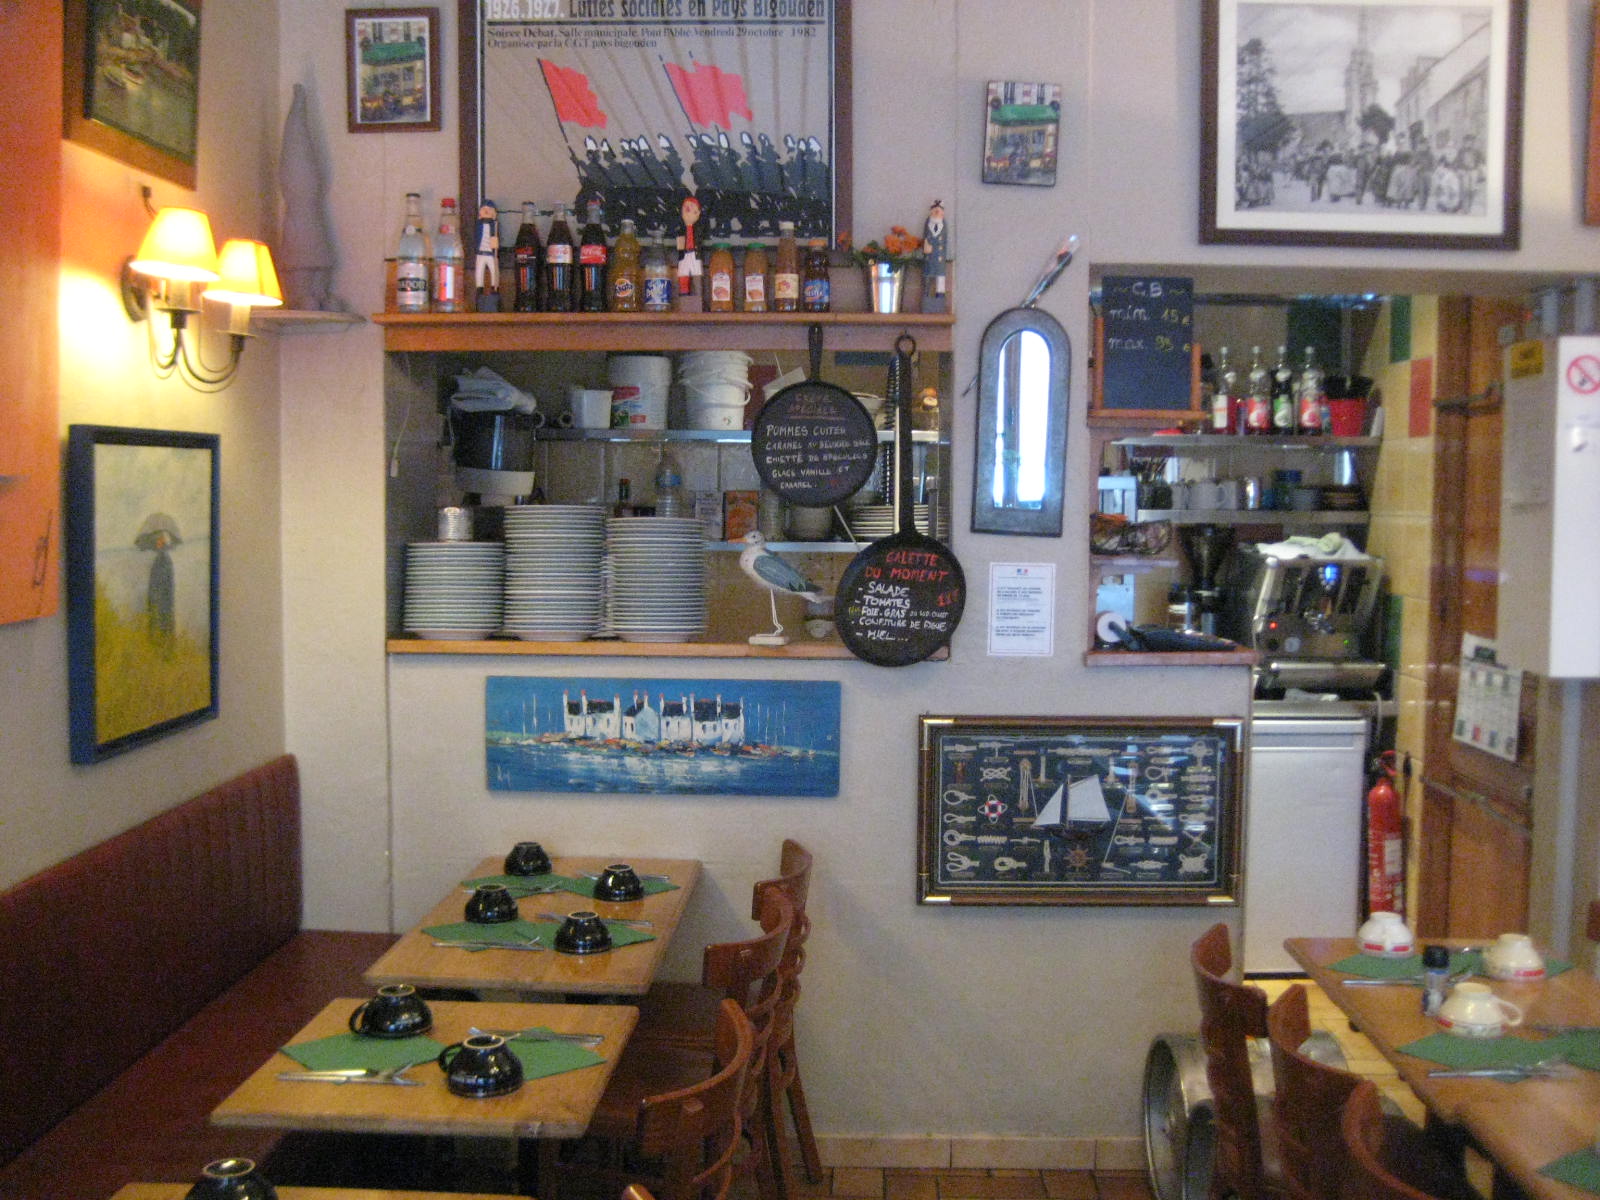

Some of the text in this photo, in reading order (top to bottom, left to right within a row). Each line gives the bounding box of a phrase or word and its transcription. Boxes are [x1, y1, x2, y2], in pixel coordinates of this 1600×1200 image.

[688, 0, 706, 17] en
[766, 424, 808, 437] POMMES
[865, 567, 949, 582] DU MOMENT
[867, 581, 911, 598] SALADE
[863, 595, 911, 609] TOMATES
[910, 620, 921, 629] DE
